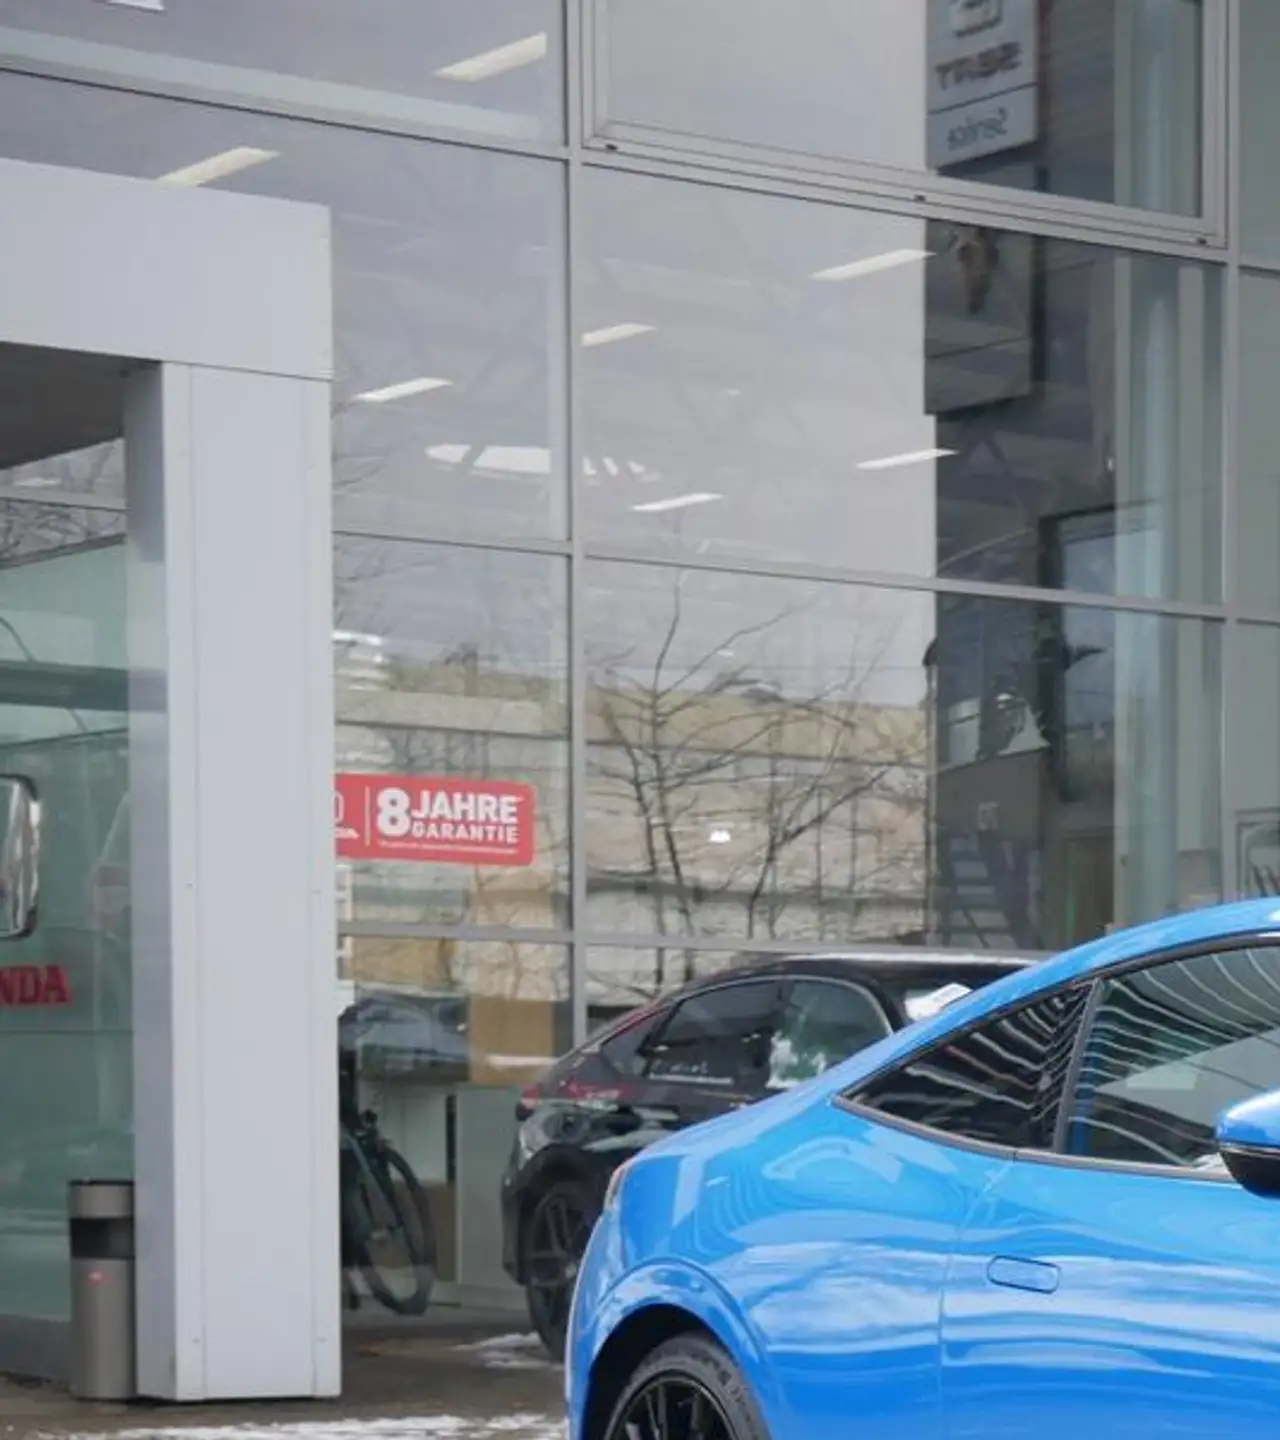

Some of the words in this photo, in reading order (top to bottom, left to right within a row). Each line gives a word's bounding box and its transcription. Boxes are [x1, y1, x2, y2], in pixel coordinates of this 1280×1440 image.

[376, 787, 411, 837] 8
[411, 789, 520, 824] JAHRE
[411, 821, 519, 844] GARANTIE
